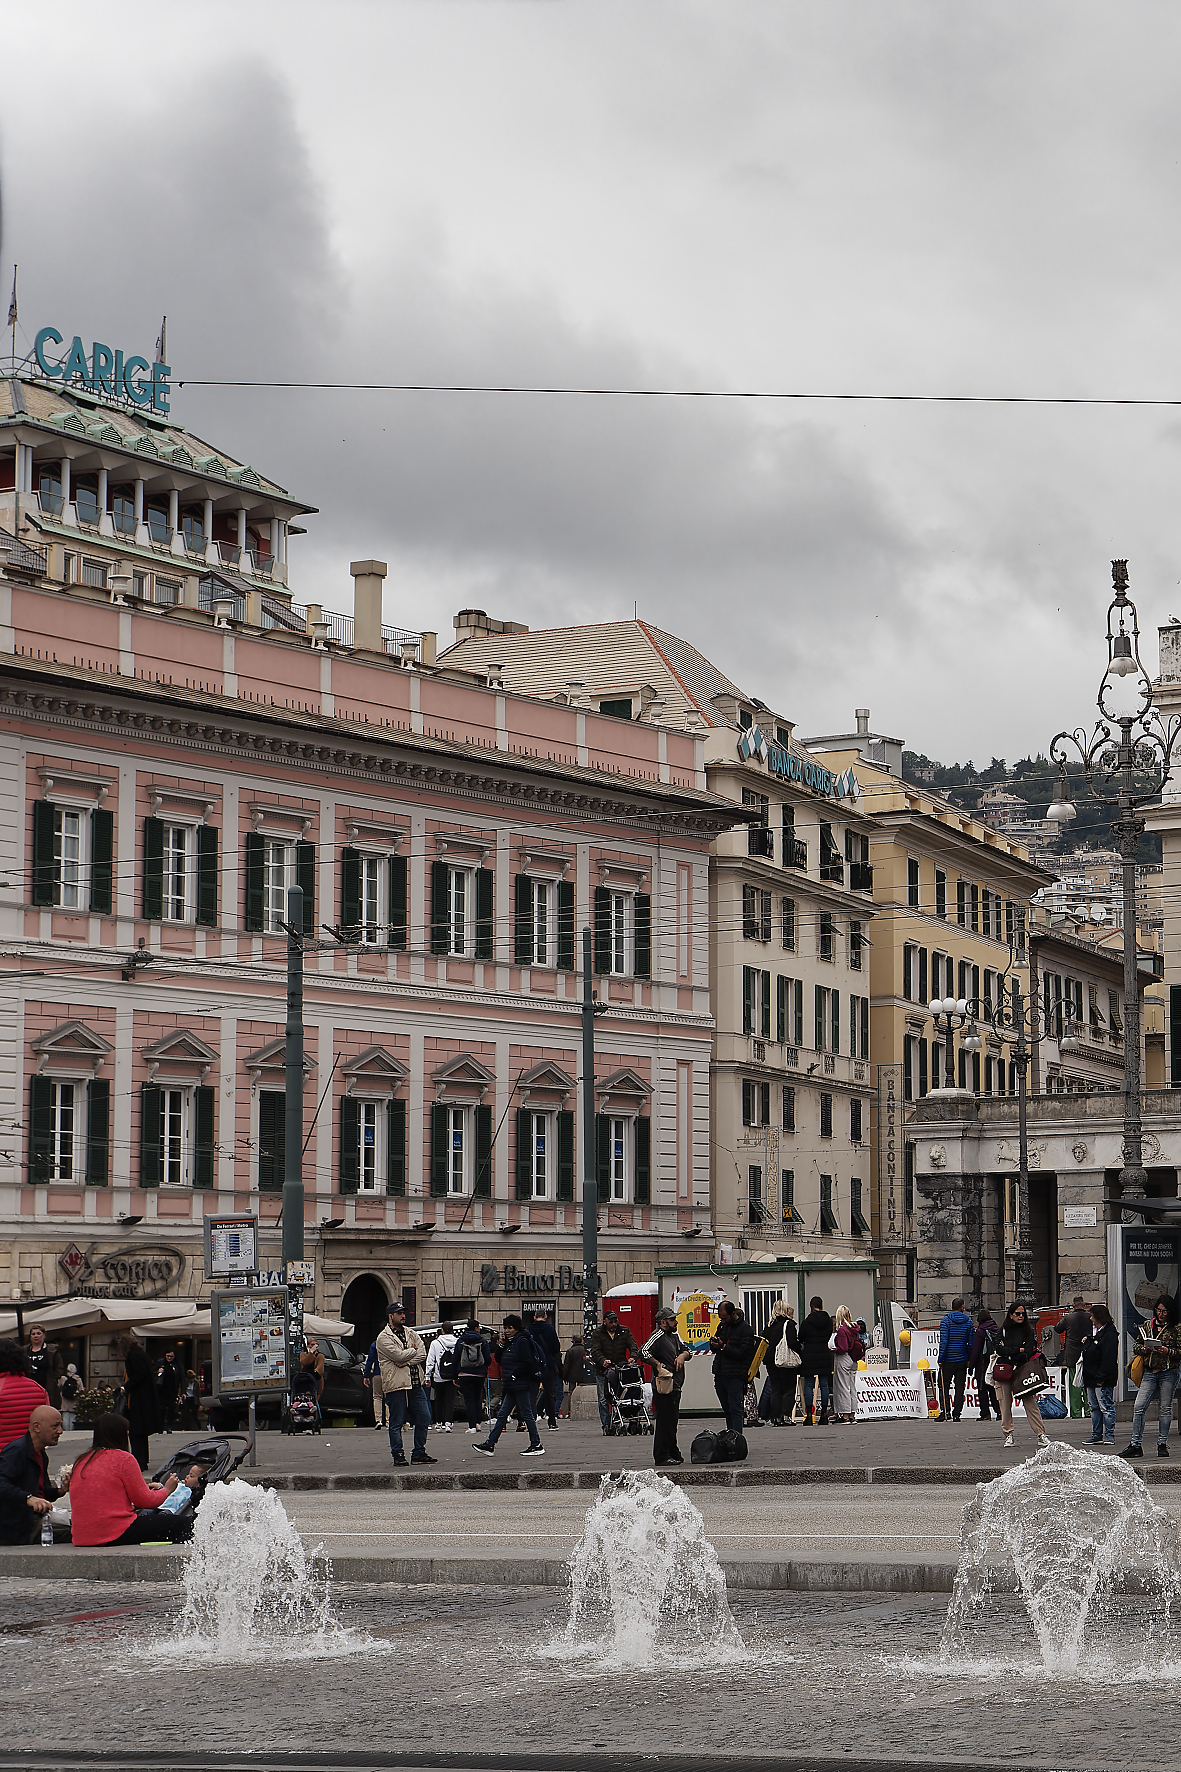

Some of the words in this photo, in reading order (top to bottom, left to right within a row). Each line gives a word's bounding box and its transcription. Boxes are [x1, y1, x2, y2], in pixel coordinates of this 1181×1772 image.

[35, 326, 171, 412] CARIGE
[769, 746, 802, 782] BANCA
[803, 761, 835, 796] CARIGE
[886, 1079, 897, 1138] BANCA
[505, 1265, 556, 1291] Banco
[523, 1303, 555, 1312] BANCOMAT
[687, 1329, 711, 1339] 110%
[893, 1375, 910, 1387] PER
[1022, 1372, 1041, 1386] coin
